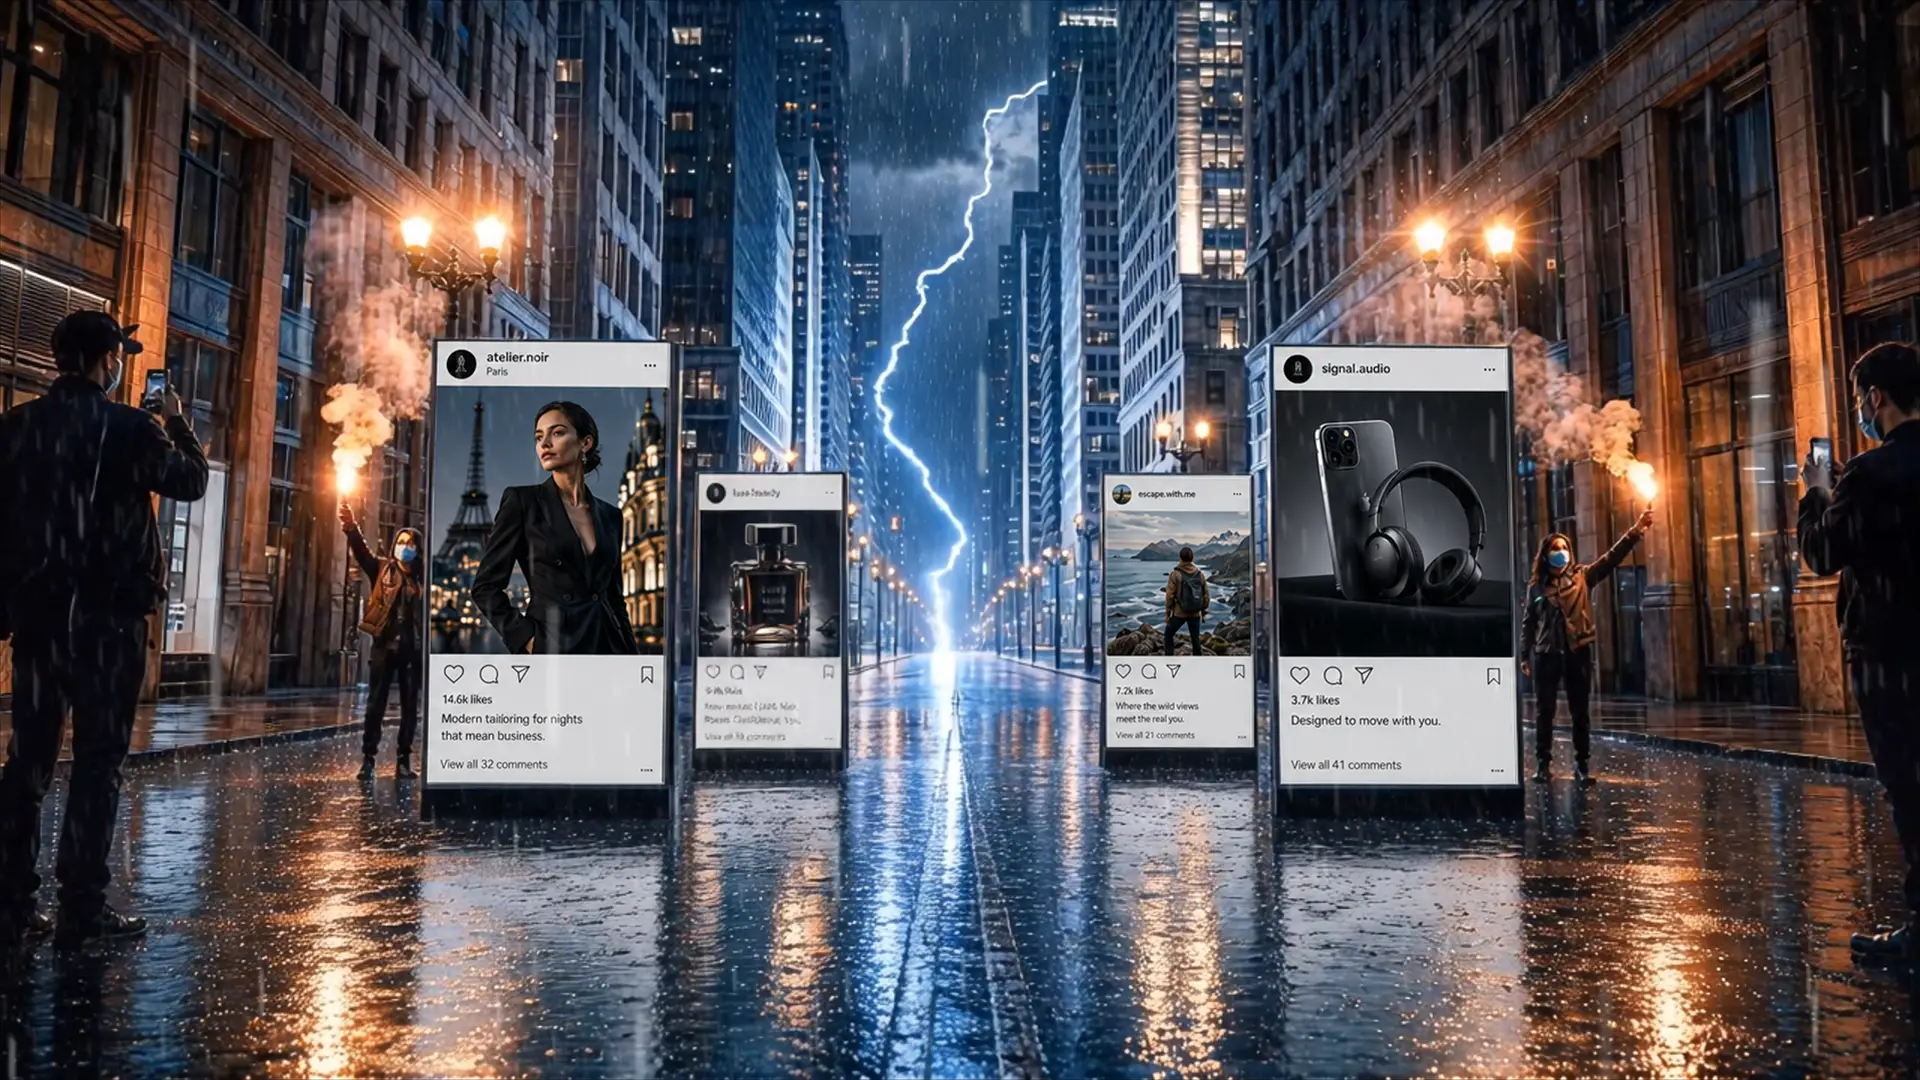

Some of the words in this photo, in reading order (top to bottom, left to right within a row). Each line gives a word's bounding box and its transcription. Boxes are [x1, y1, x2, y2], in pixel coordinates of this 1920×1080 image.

[486, 351, 549, 363] atelier.noir
[486, 366, 509, 377] Paris
[1321, 362, 1391, 377] signal.audio
[1138, 489, 1196, 499] escape.with.me
[1116, 686, 1134, 696] 7.2k
[1135, 686, 1154, 696] likes
[442, 694, 468, 705] 14.6k
[470, 694, 493, 705] likes
[1291, 694, 1314, 706] 3.7k
[1316, 694, 1340, 706] likes
[1116, 701, 1142, 711] Where
[1143, 701, 1156, 711] the
[1158, 701, 1175, 711] wild
[1176, 701, 1199, 711] views
[441, 713, 482, 725] Modern
[533, 713, 547, 725] for
[550, 713, 584, 727] nights
[1116, 715, 1136, 724] meet
[1138, 715, 1151, 724] the
[1152, 715, 1167, 724] real
[1169, 716, 1184, 724] you.
[1291, 714, 1342, 728] Designed
[1345, 715, 1356, 726] to
[1359, 717, 1389, 726] move
[1392, 714, 1416, 726] with
[1418, 717, 1441, 728] you.
[441, 730, 463, 742] that
[465, 733, 495, 742] mean
[497, 730, 546, 742] business.
[1116, 731, 1134, 740] View
[1135, 731, 1143, 740] all
[1145, 731, 1154, 740] 21
[1156, 731, 1195, 740] comments
[440, 758, 464, 770] View
[467, 758, 479, 770] all
[481, 758, 494, 770] 32
[496, 759, 548, 770] comments
[1291, 759, 1316, 770] View
[1318, 759, 1330, 770] all
[1332, 759, 1345, 770] 41
[1348, 760, 1402, 770] comments
